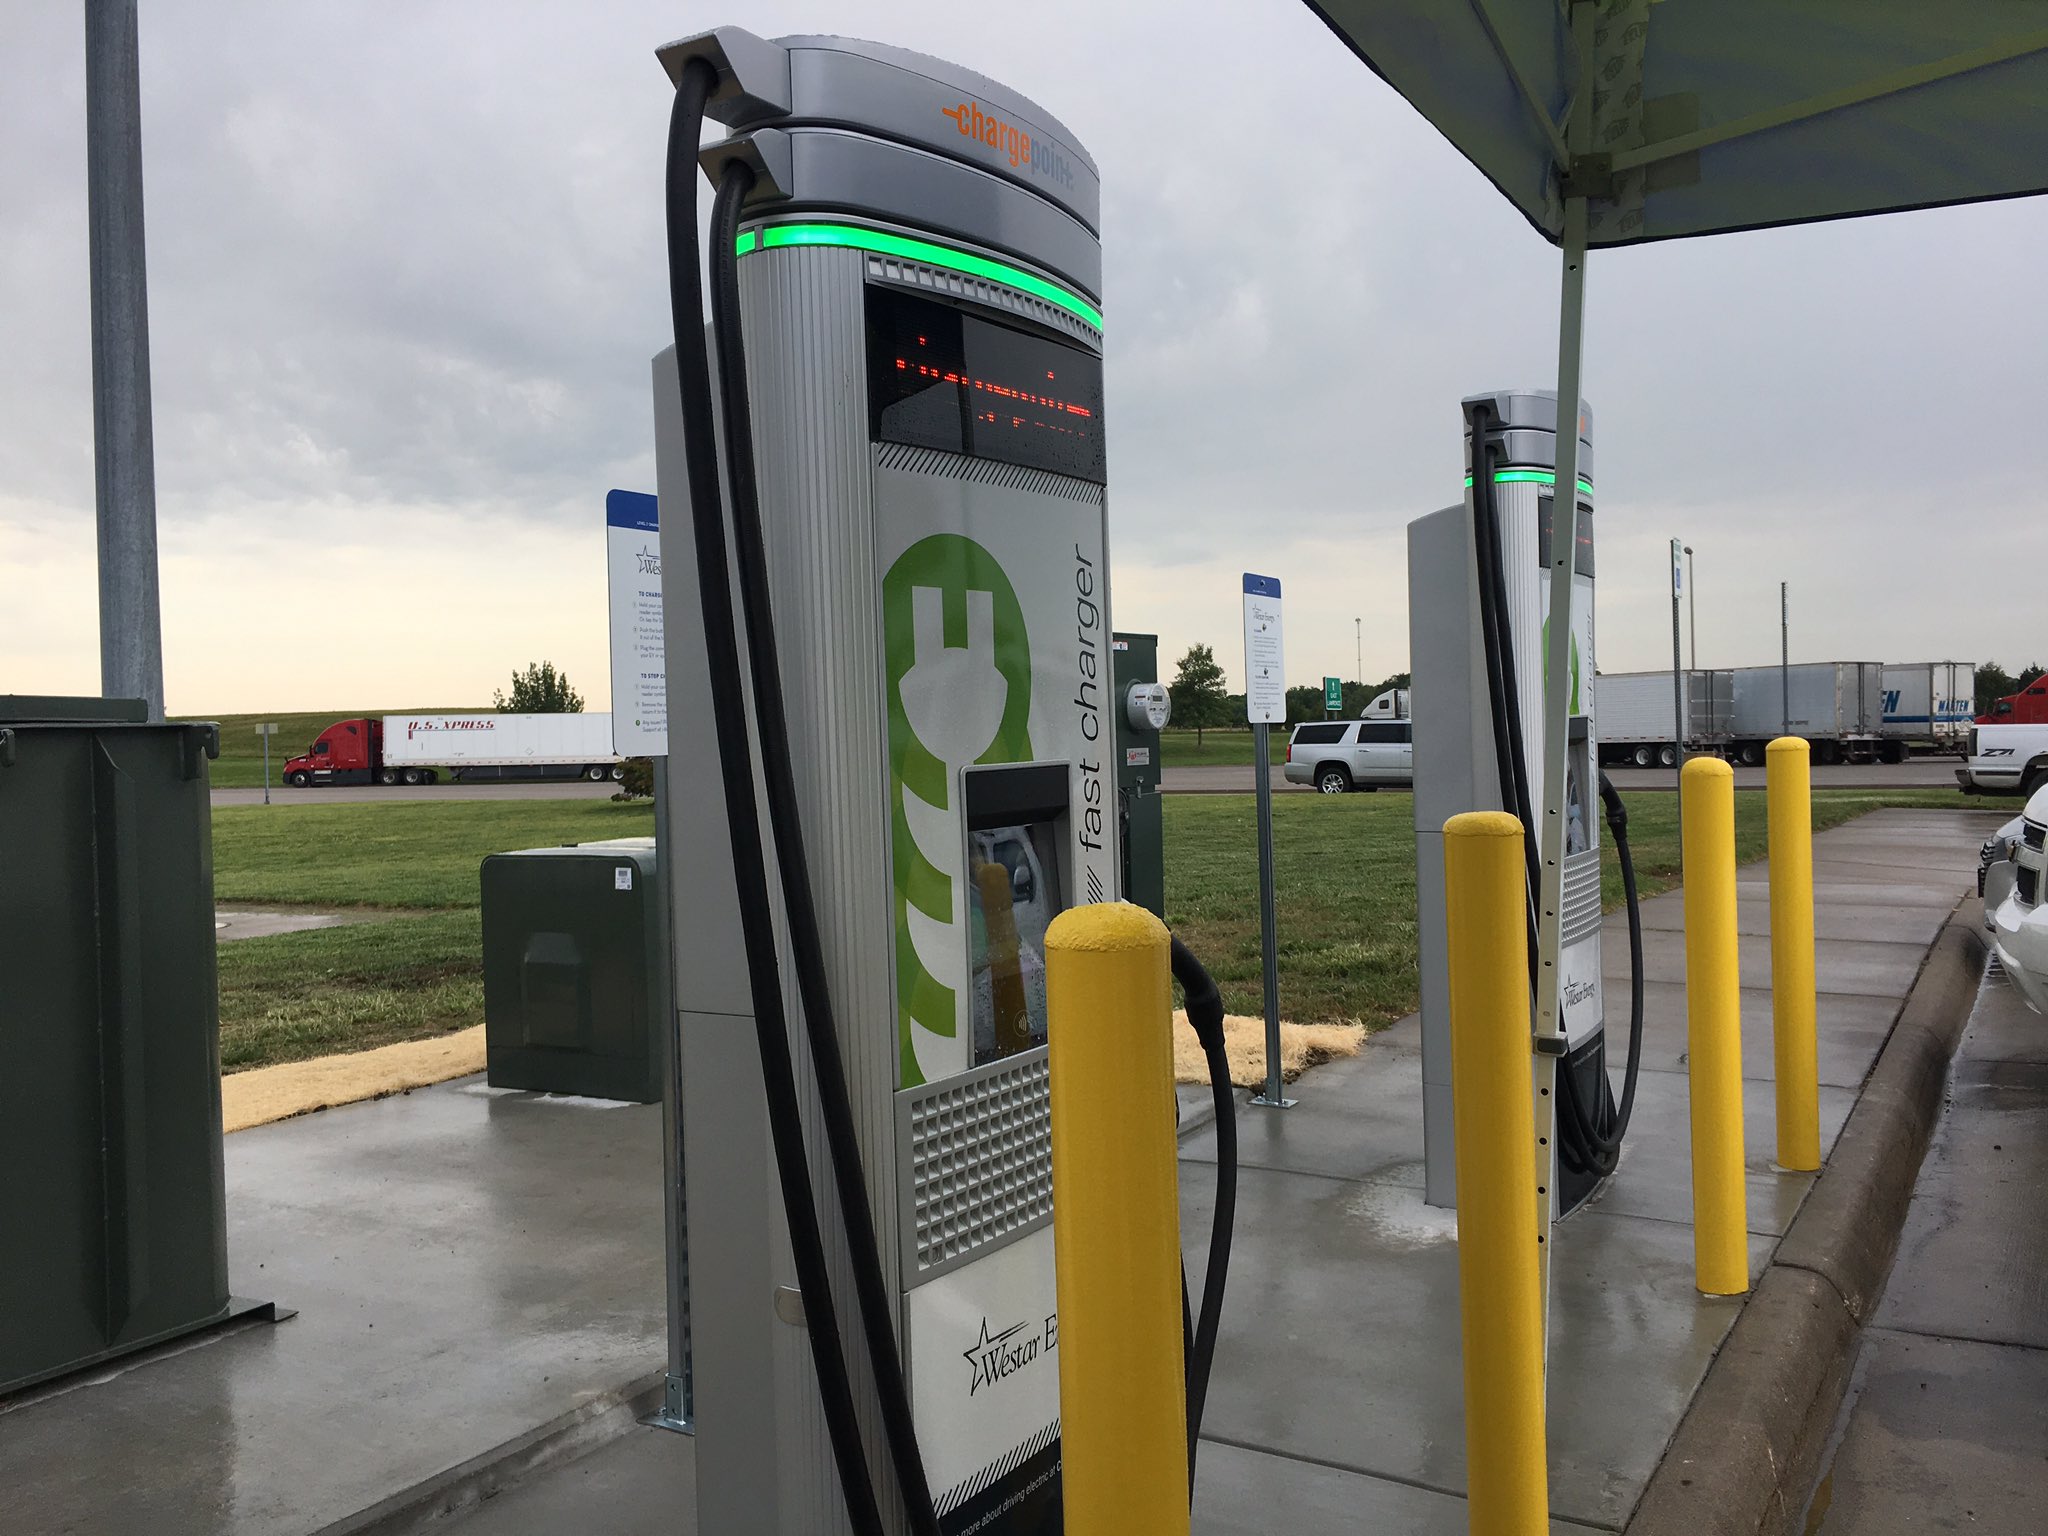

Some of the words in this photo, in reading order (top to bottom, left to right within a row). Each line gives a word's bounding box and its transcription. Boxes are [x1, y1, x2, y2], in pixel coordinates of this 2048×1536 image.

[1074, 543, 1100, 742] charger
[408, 721, 439, 730] U.S.
[443, 721, 495, 730] XPRESS
[1980, 748, 2016, 757] Z71
[1079, 757, 1102, 853] fast
[981, 1335, 1040, 1388] Westar
[1044, 1313, 1059, 1353] E
[981, 1503, 1002, 1526] about
[1002, 1489, 1025, 1512] driving
[1026, 1471, 1049, 1495] electric
